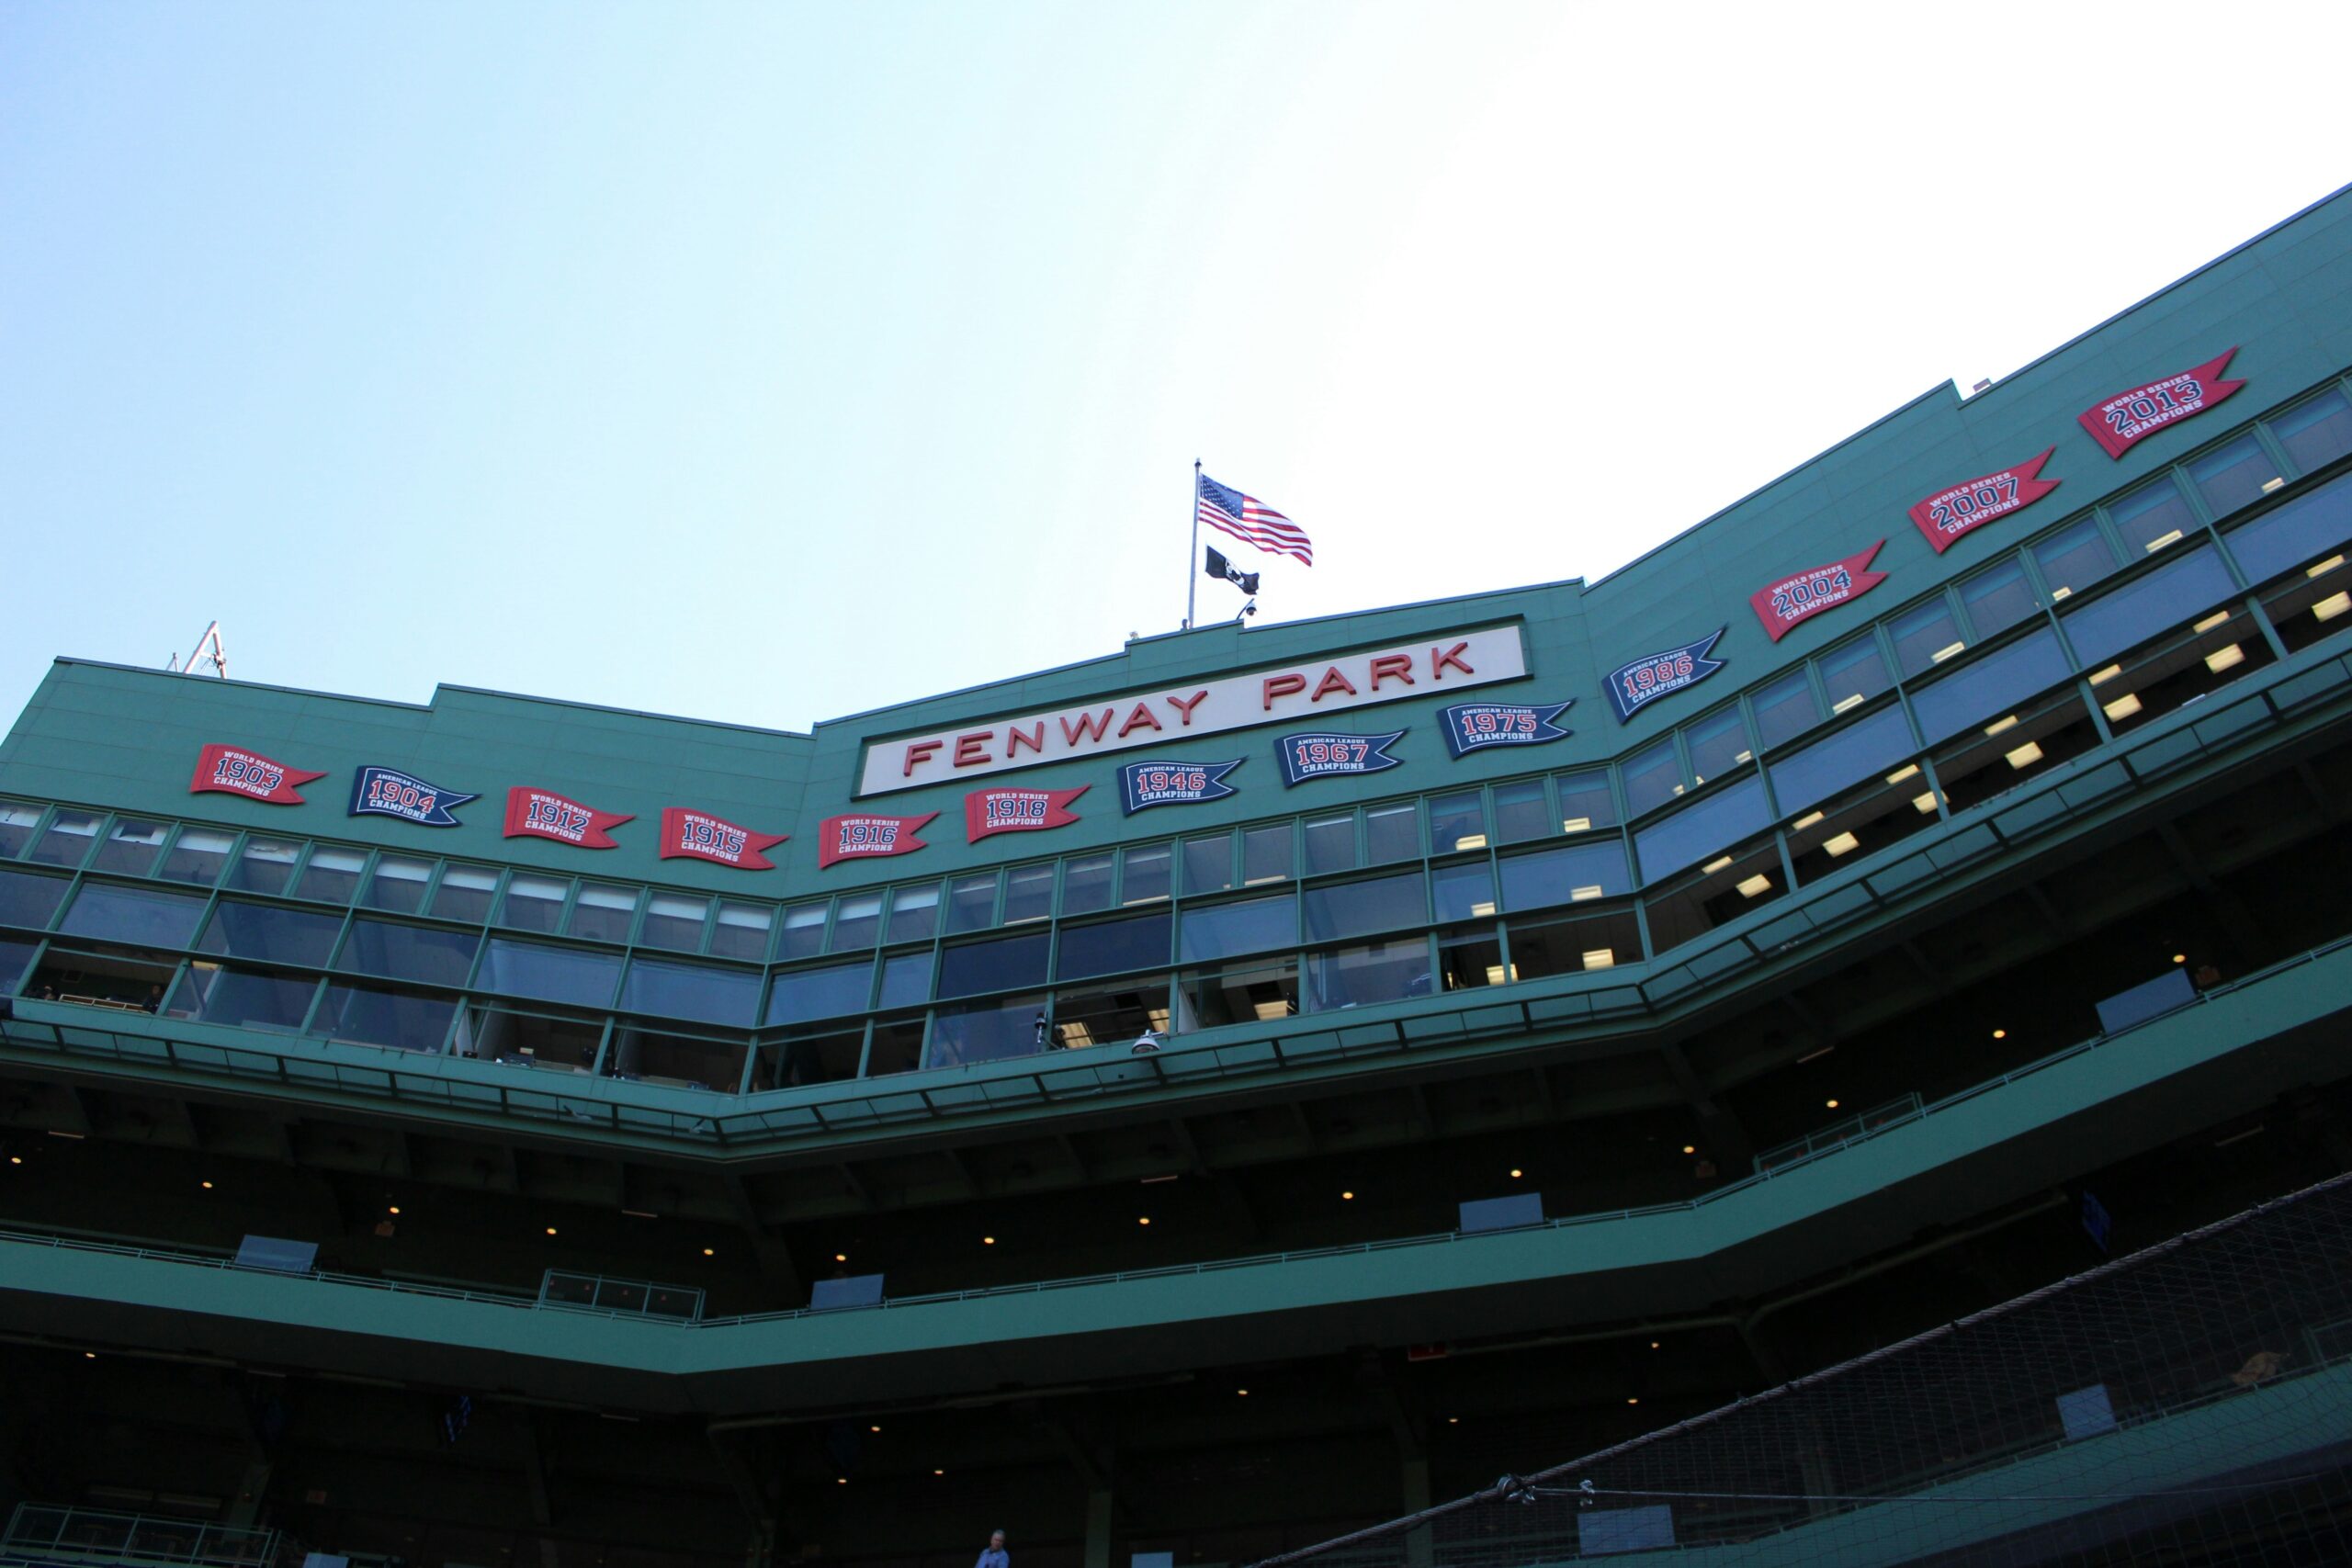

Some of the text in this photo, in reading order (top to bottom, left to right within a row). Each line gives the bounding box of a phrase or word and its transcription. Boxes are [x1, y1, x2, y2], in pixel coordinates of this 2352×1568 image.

[2102, 374, 2190, 412] WORLD SERIES
[2106, 380, 2202, 434] 2013
[2123, 400, 2202, 438] CHAMPIONS
[1930, 472, 2010, 507] WORLD SERIES
[1930, 477, 2018, 530] 2007
[1948, 498, 2019, 533] CHAMPIONS
[1772, 565, 1843, 594] WORLD SERIES
[1772, 570, 1851, 616] 2004
[1785, 590, 1849, 620] CHAMPIONS
[1623, 650, 1687, 677] AMERICAN LEAGUE
[1623, 656, 1692, 698] 1986
[1632, 675, 1690, 703] CHAMPIONS
[903, 642, 1474, 777] FENWAY PARK
[1462, 714, 1536, 736] 1975
[1469, 733, 1532, 742] CHAMPIONS
[224, 751, 284, 773] WORLD SERIES
[1296, 744, 1368, 765] 1967
[214, 758, 282, 790] 1903
[1303, 762, 1364, 773] CHAMPIONS
[213, 776, 270, 796] CHAMPIONS
[377, 773, 437, 795] AMERICAN LEAGUE
[1137, 773, 1206, 794] 1946
[368, 780, 435, 813] 1904
[530, 794, 592, 818] WORLD SERIES
[1141, 791, 1201, 801] CHAMPIONS
[369, 800, 426, 819] CHAMPIONS
[527, 801, 589, 834] 1912
[987, 799, 1046, 819] 1918
[526, 820, 582, 841] CHAMPIONS
[684, 815, 747, 838] WORLD SERIES
[987, 818, 1044, 828] CHAMPIONS
[683, 822, 745, 854] 1915
[840, 826, 898, 846] 1916
[681, 841, 739, 862] CHAMPIONS
[839, 844, 893, 853] CHAMPIONS
